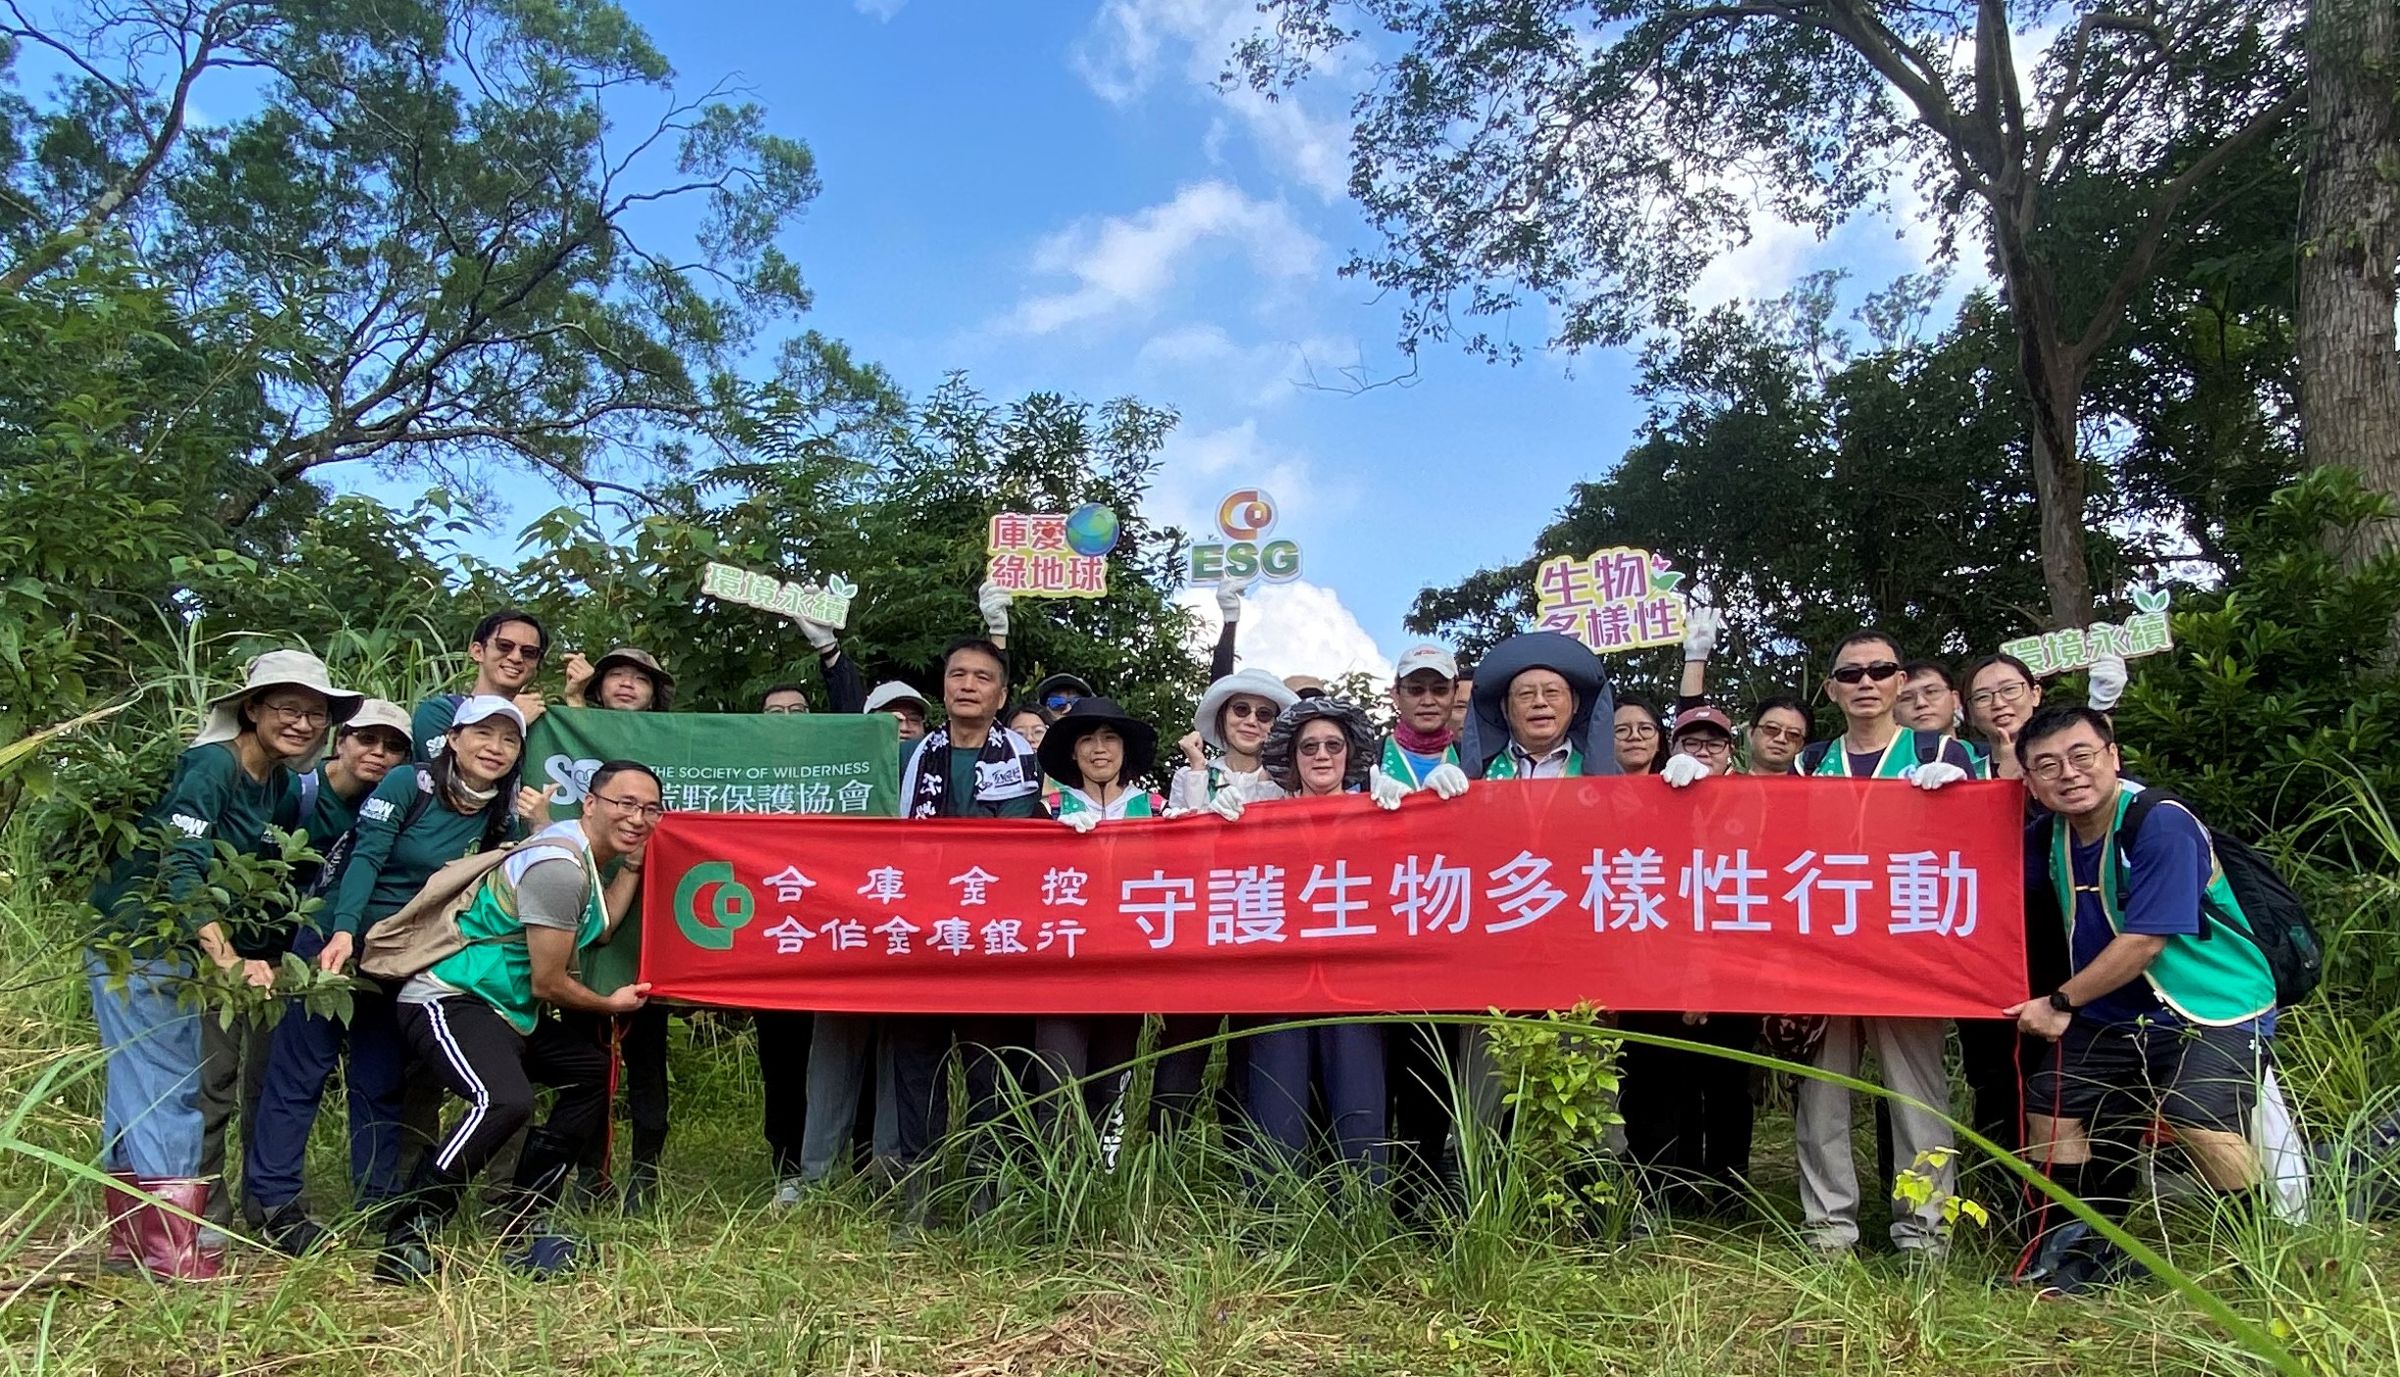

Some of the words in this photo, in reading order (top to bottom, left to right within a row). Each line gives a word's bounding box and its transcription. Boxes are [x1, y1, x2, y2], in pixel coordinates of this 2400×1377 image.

[993, 515, 1067, 550] 庫愛
[991, 554, 1103, 591] 綠地球
[1191, 541, 1300, 580] ESG
[1541, 552, 1648, 611] 生物
[707, 564, 848, 625] 環境永續
[2003, 612, 2168, 672] 環境永續
[679, 766, 742, 779] SOCIETY
[746, 767, 769, 779] OF
[773, 761, 870, 779] WILDERNESS
[661, 779, 874, 815] 荒野保護協會
[762, 864, 1089, 906] 合庫金控
[1117, 846, 1980, 950] 守護生物多樣性行動
[763, 914, 1088, 958] 合作金庫銀行
